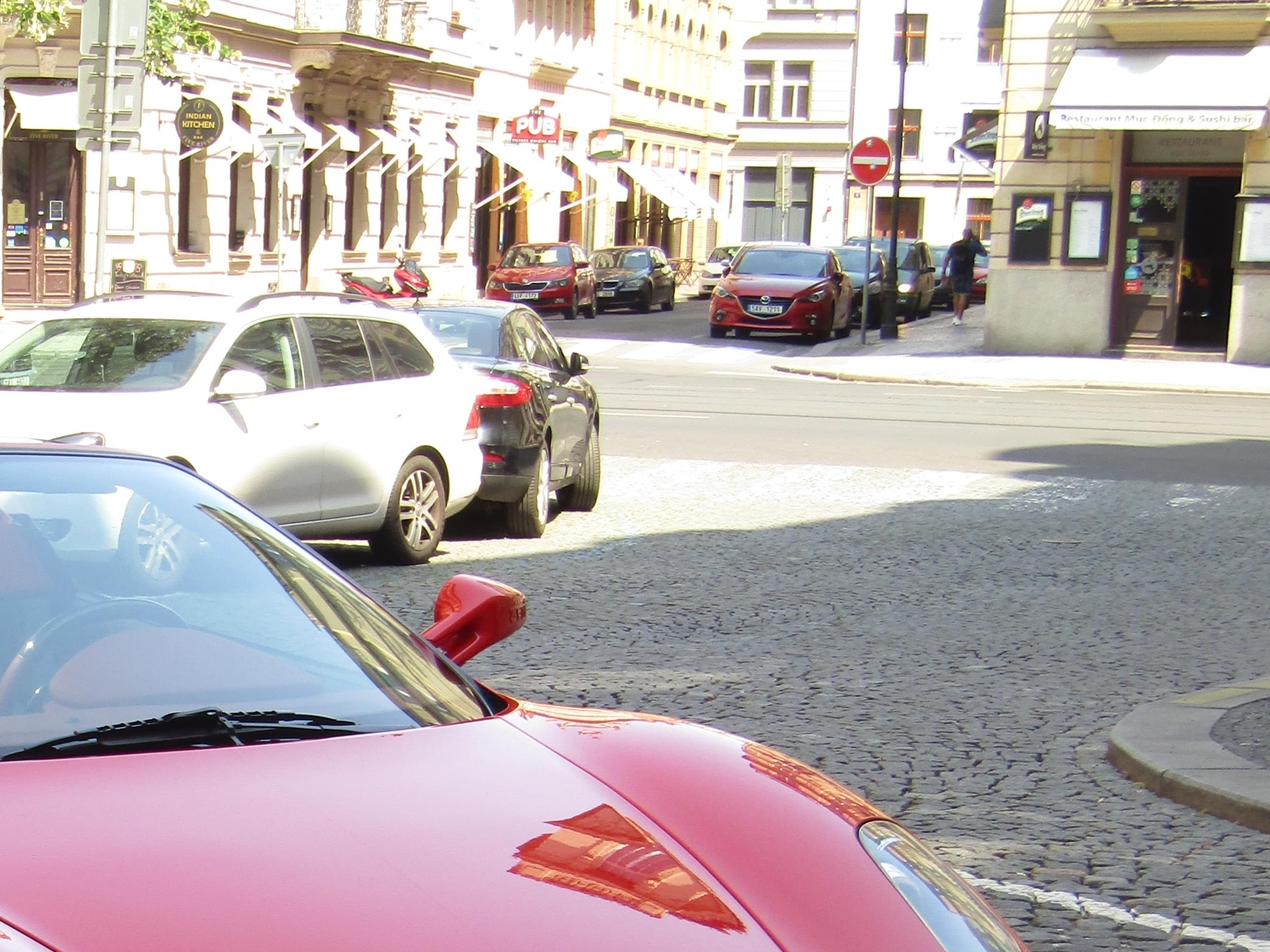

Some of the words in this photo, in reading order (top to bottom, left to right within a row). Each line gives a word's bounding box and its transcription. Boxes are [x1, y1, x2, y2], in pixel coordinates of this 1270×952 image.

[1061, 114, 1122, 123] Restaurant
[1187, 115, 1196, 123] &
[1199, 115, 1230, 123] Sushi
[182, 121, 216, 129] KITCHEN
[515, 117, 557, 135] PUB
